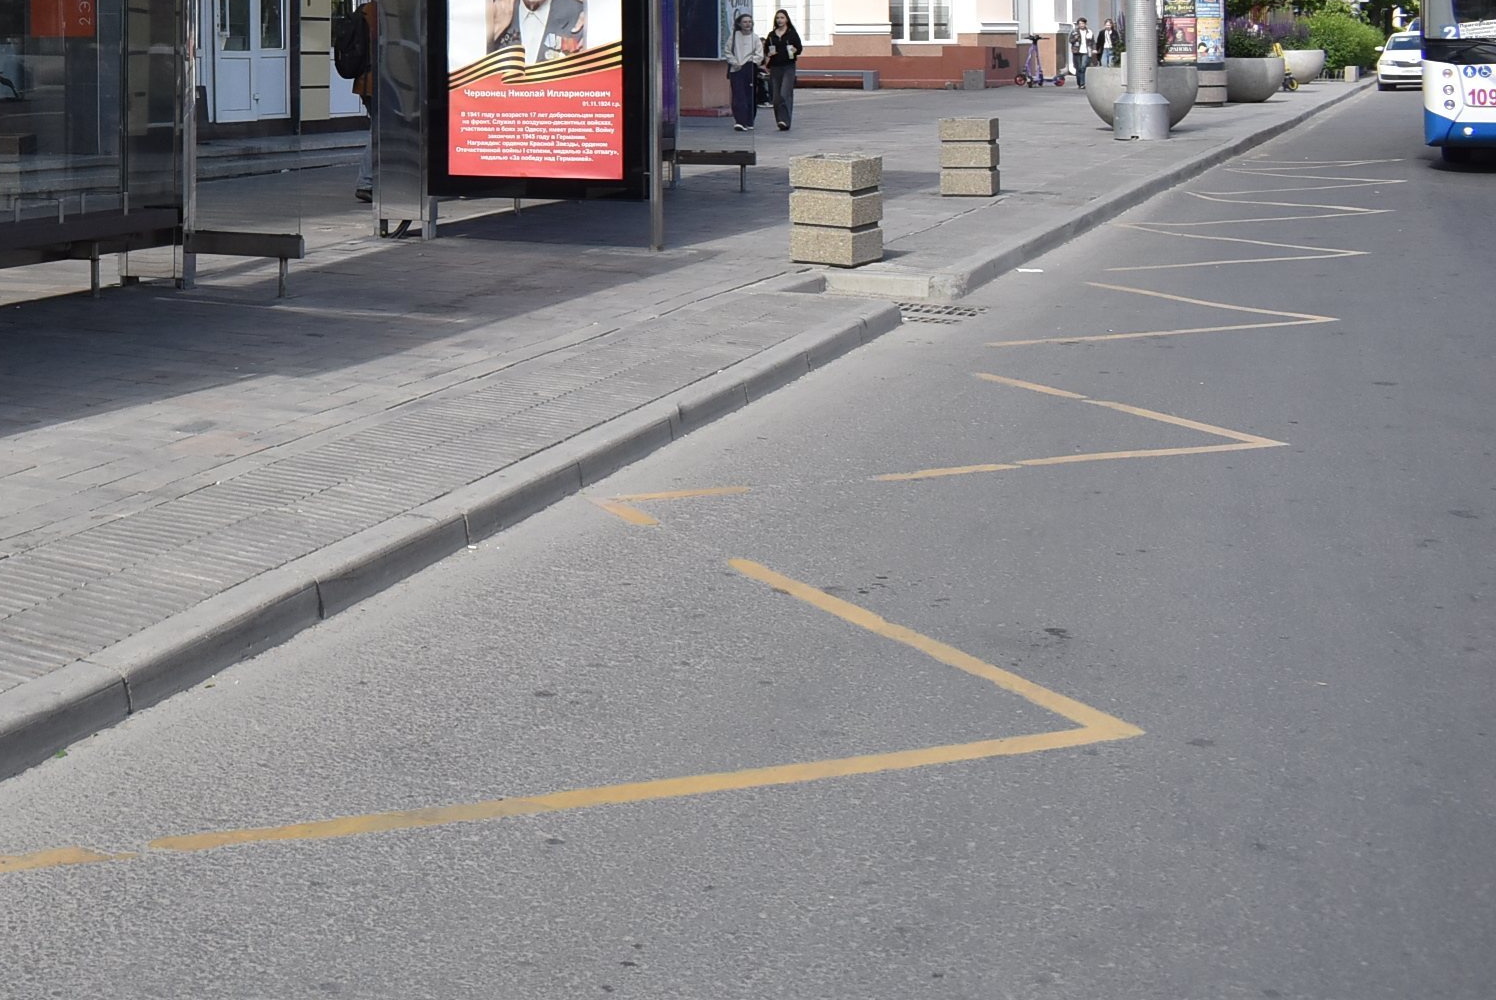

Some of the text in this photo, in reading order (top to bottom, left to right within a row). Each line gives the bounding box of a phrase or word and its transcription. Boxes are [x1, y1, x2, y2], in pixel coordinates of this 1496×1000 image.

[1443, 26, 1457, 39] 2
[464, 90, 506, 98] Червонец
[547, 90, 611, 98] Илларионович
